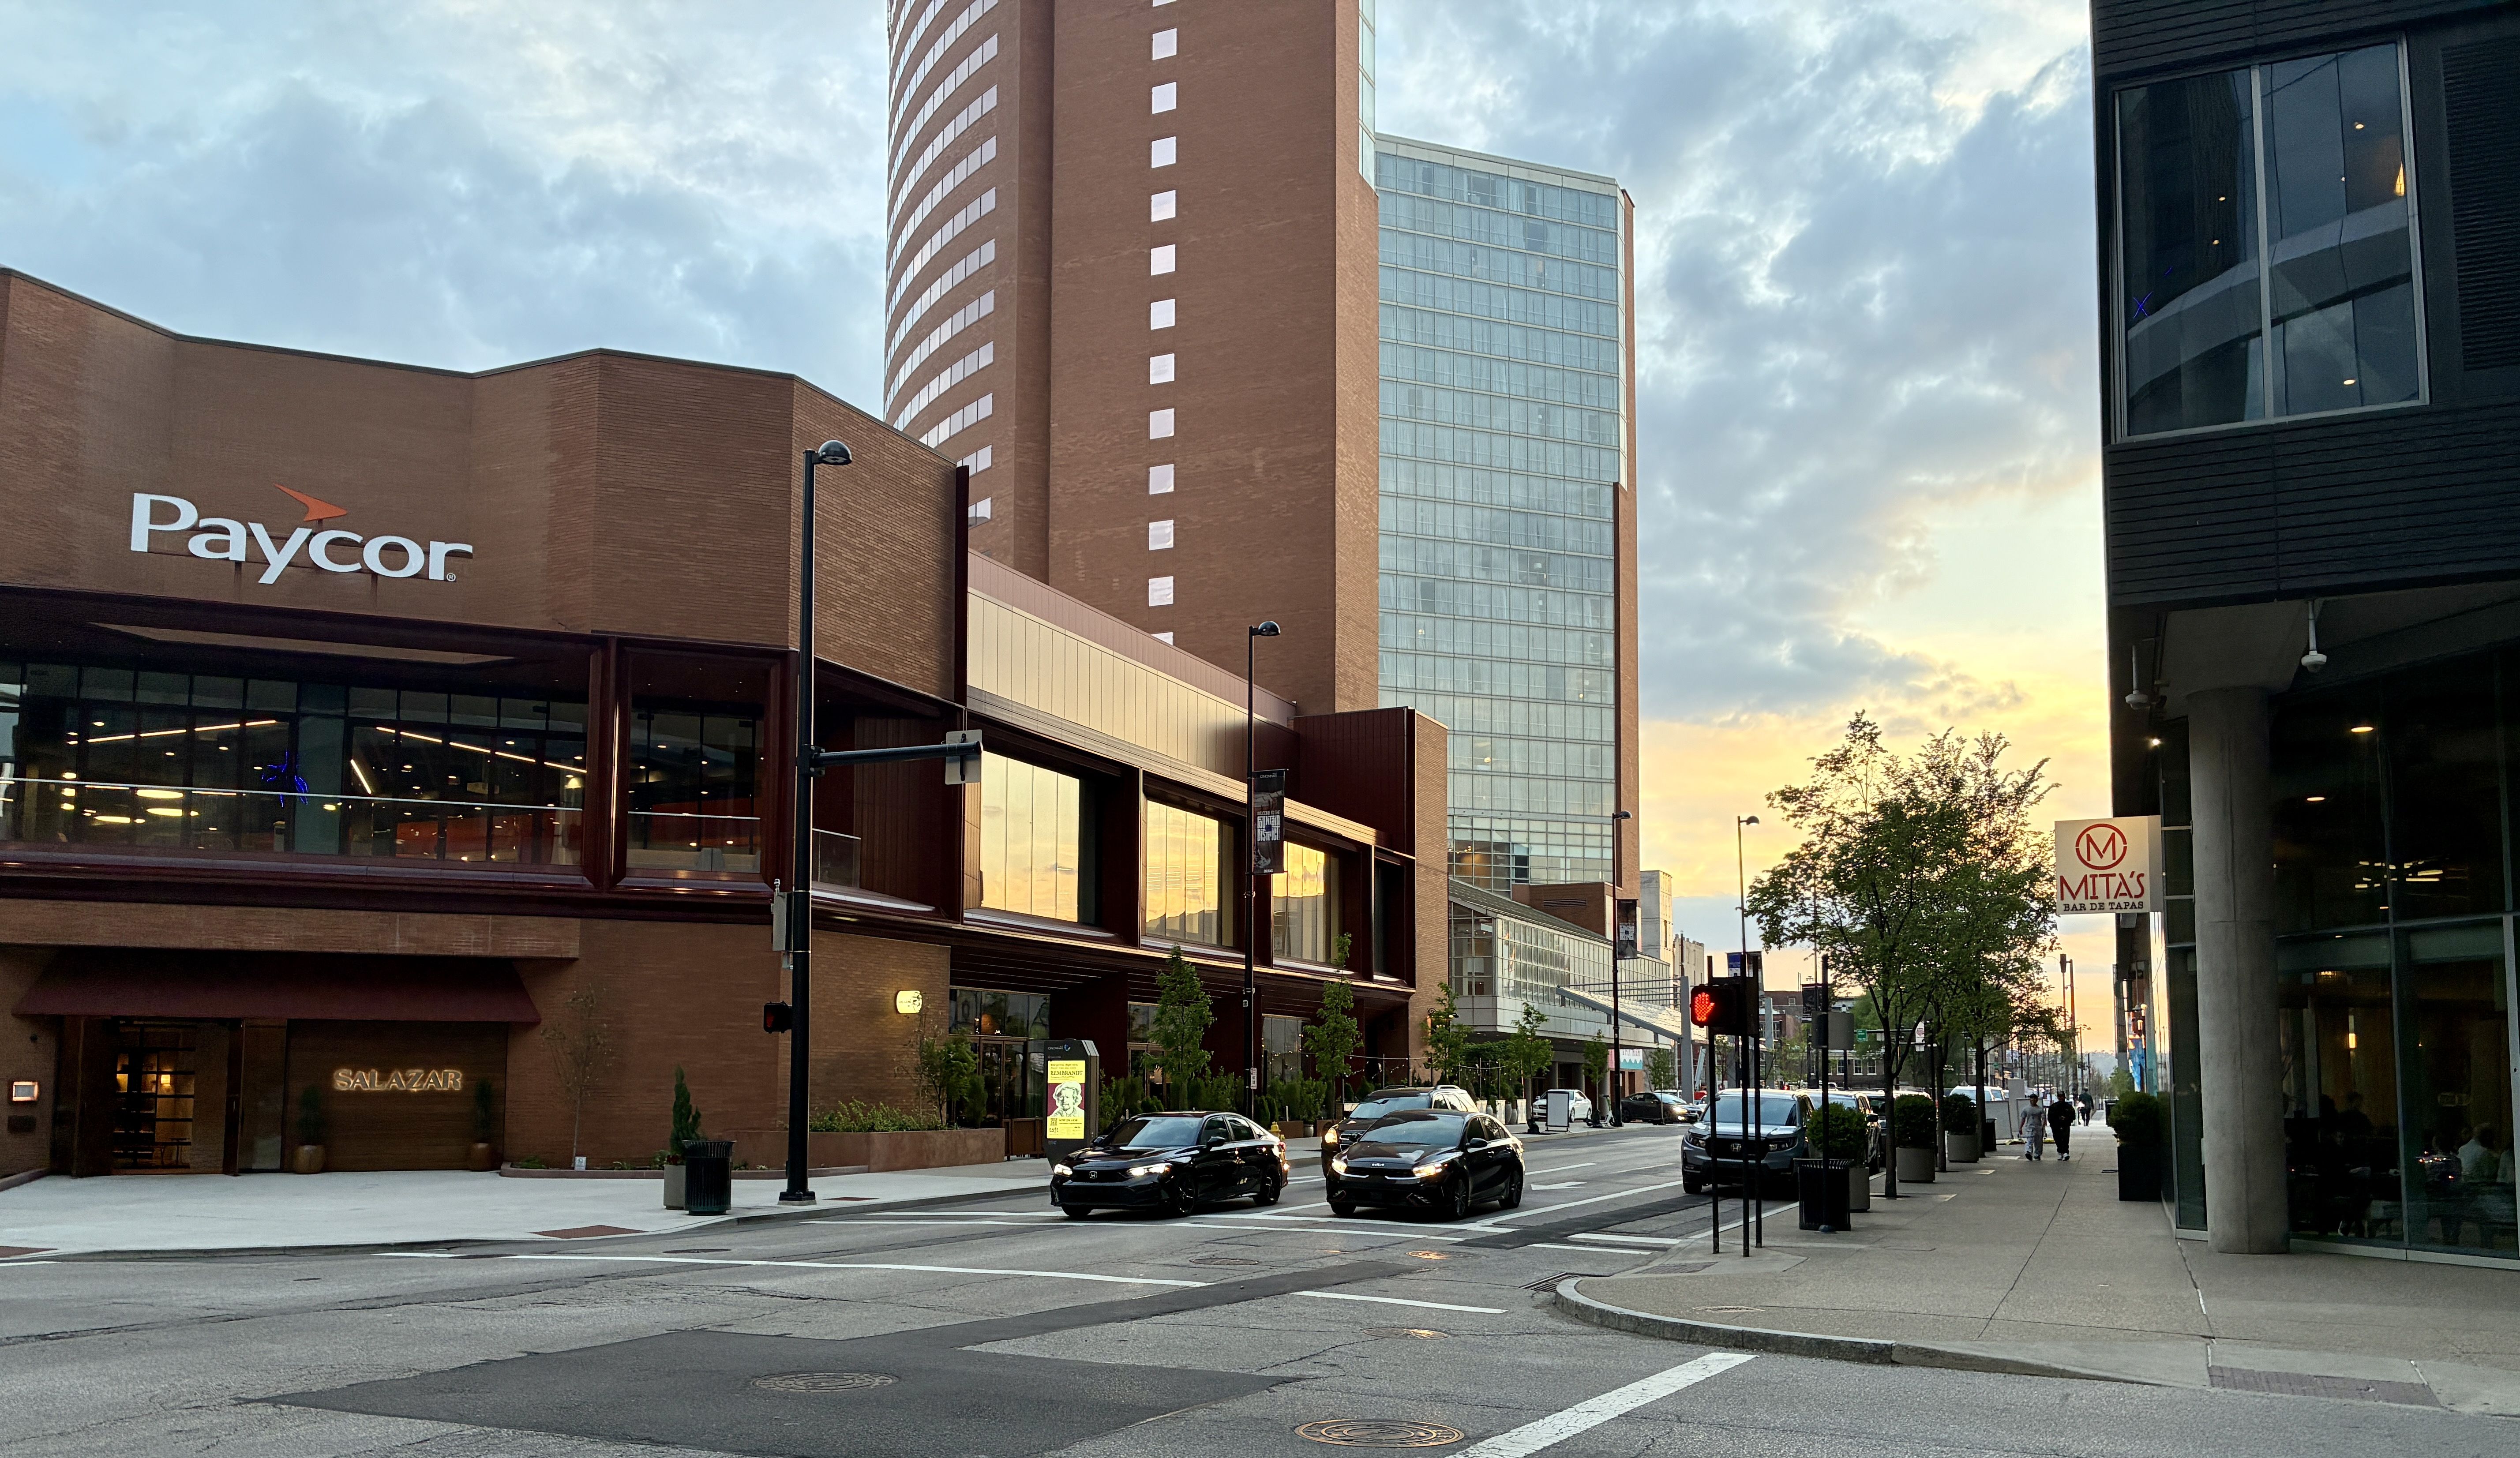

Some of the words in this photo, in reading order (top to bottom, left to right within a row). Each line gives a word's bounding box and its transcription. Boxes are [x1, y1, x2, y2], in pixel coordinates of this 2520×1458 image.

[131, 492, 473, 584] Paycor
[2086, 832, 2116, 862] M
[2059, 871, 2145, 901] MITA'S
[2063, 903, 2087, 911] BAR
[2108, 901, 2144, 910] TAPAS
[334, 1068, 463, 1091] SALAZAR
